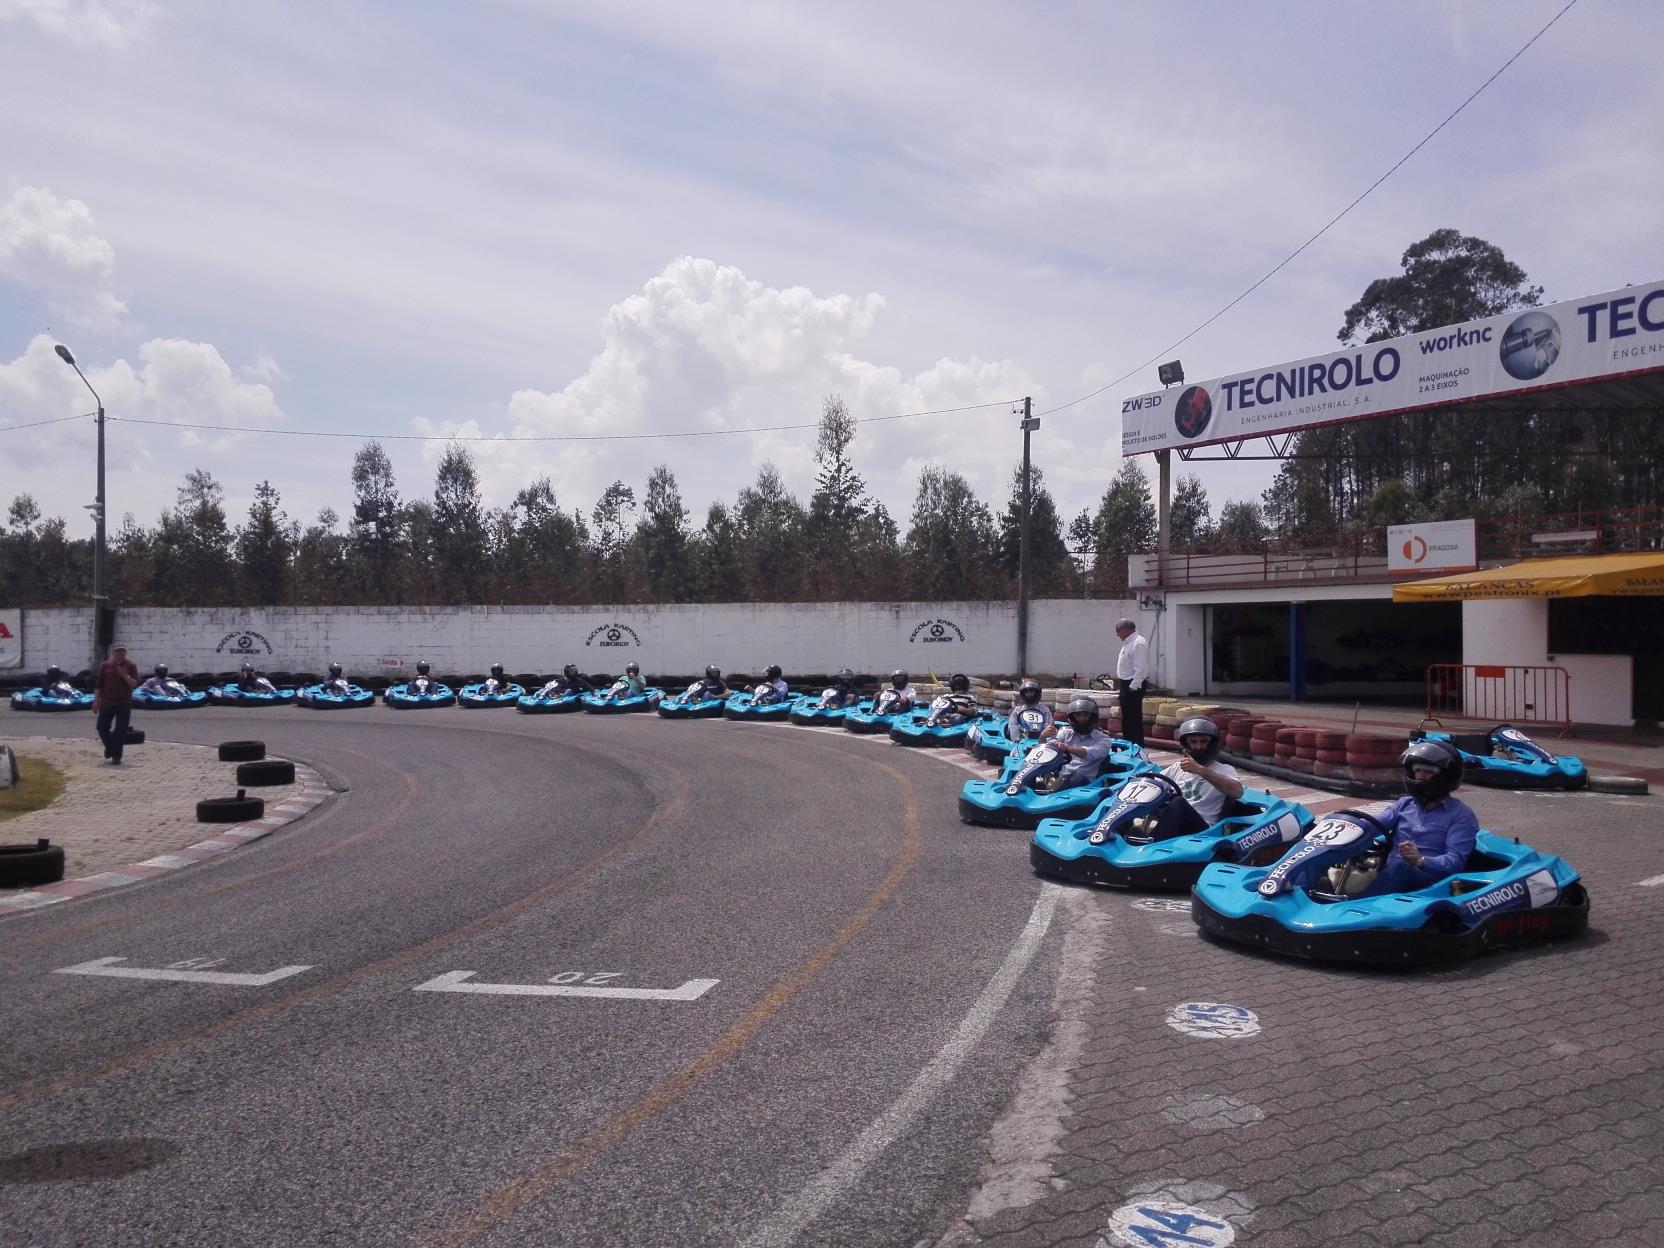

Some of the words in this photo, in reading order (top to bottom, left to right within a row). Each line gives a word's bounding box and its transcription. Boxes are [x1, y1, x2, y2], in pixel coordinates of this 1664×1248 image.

[1419, 326, 1492, 355] worknc
[1221, 347, 1401, 412] TECNIROLO
[1418, 367, 1470, 383] MAQUINAÇÃO
[1436, 380, 1458, 390] EIXOS
[1241, 410, 1293, 425] ENGENHARIA
[585, 624, 610, 647] ESCOLA
[614, 623, 641, 647] KARTING
[909, 620, 933, 643] ESCOLA
[937, 619, 966, 642] KARTING
[1033, 750, 1044, 761] 9
[1127, 784, 1150, 799] 17
[1238, 824, 1278, 851] TECNIROLO
[1312, 821, 1345, 841] 23
[1466, 882, 1525, 915] TECNIROLO
